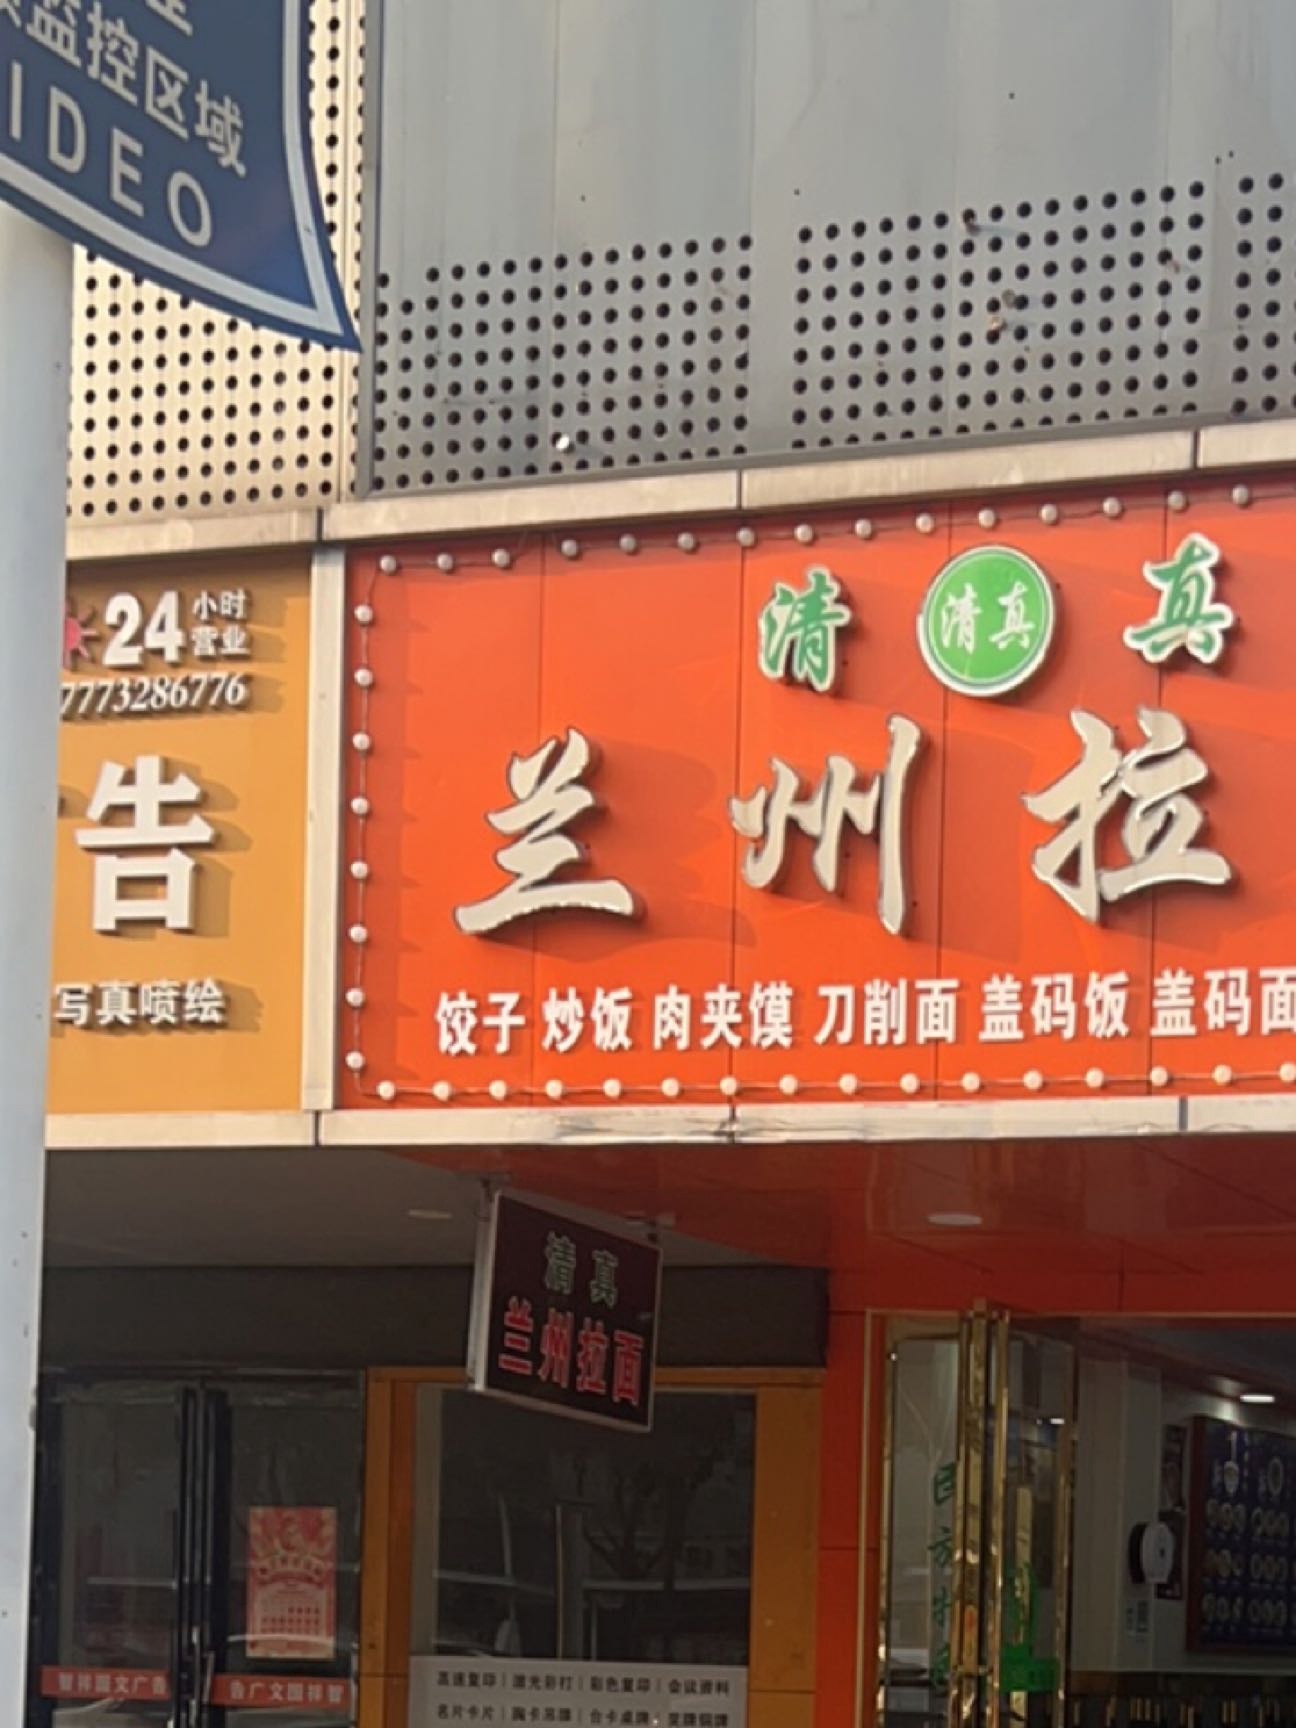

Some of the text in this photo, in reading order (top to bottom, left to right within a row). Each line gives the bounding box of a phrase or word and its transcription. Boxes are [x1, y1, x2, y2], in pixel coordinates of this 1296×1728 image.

[103, 590, 186, 669] 24
[190, 625, 250, 658] 营业
[192, 589, 247, 622] 小时
[757, 565, 852, 692] 清
[1122, 532, 1234, 664] 真
[74, 754, 216, 932] 告
[54, 977, 227, 1026] 写真喷绘
[435, 990, 527, 1056] 饺子
[541, 985, 633, 1053] 炒饭
[652, 979, 794, 1051] 肉夹馍
[813, 977, 960, 1046] 刀削面
[978, 970, 1131, 1043] 盖码饭
[497, 1294, 646, 1407] 兰州拉面
